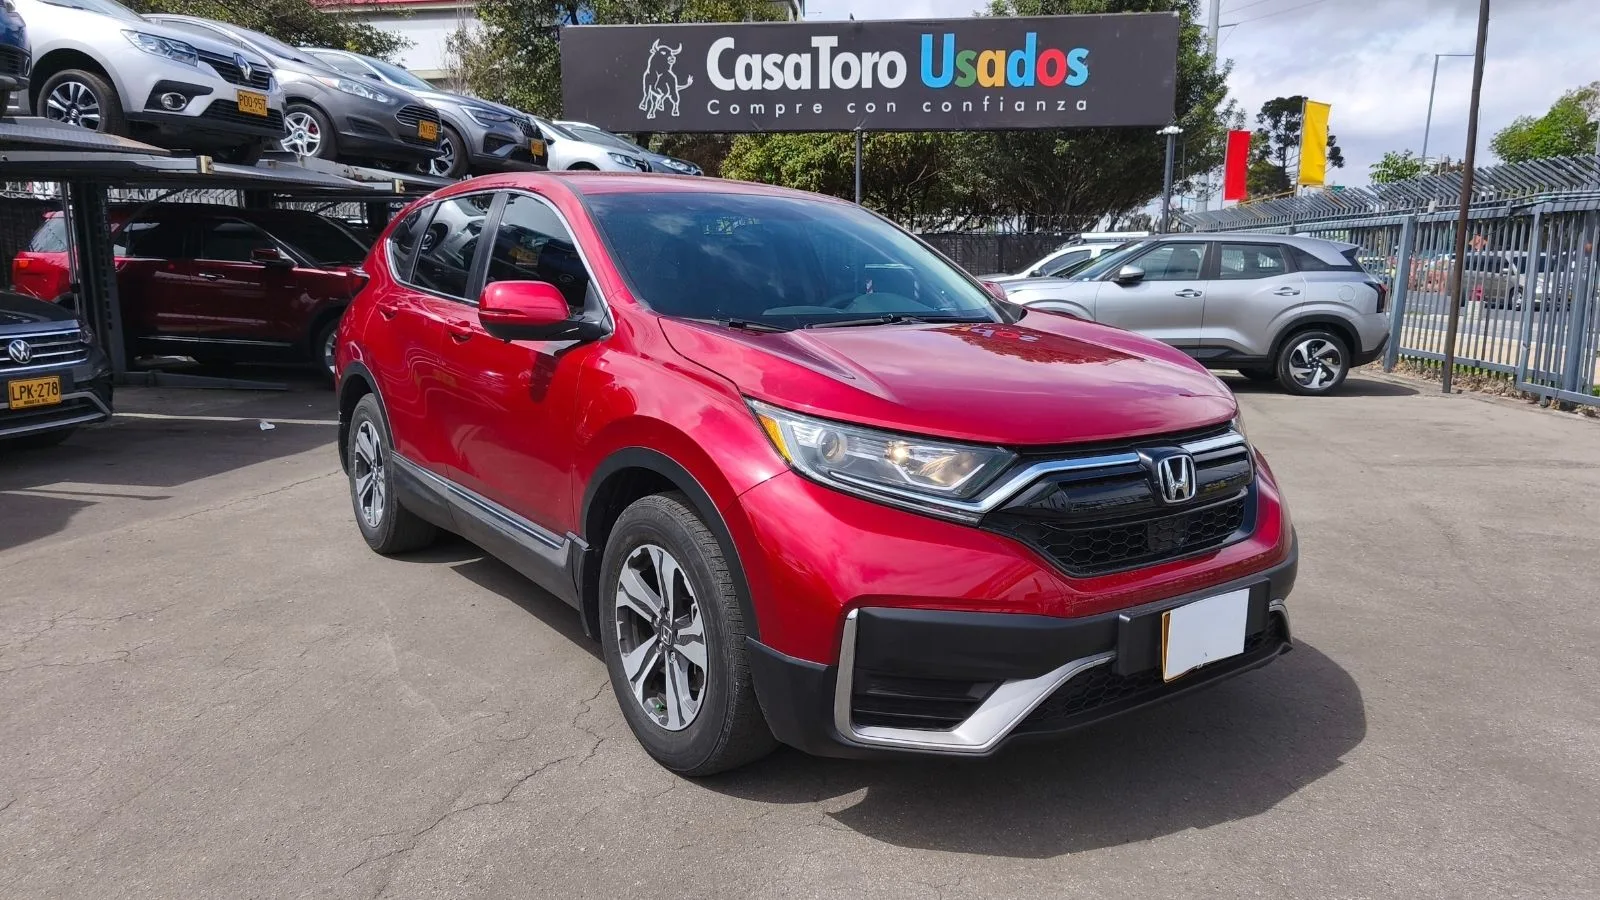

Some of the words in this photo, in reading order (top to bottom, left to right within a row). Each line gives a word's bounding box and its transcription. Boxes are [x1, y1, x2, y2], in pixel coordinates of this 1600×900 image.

[706, 35, 908, 92] CasaToro
[920, 31, 1090, 89] Usados
[707, 99, 824, 118] Compre
[846, 101, 897, 114] con
[922, 96, 1088, 113] confianza
[11, 381, 59, 401] LPK-278
